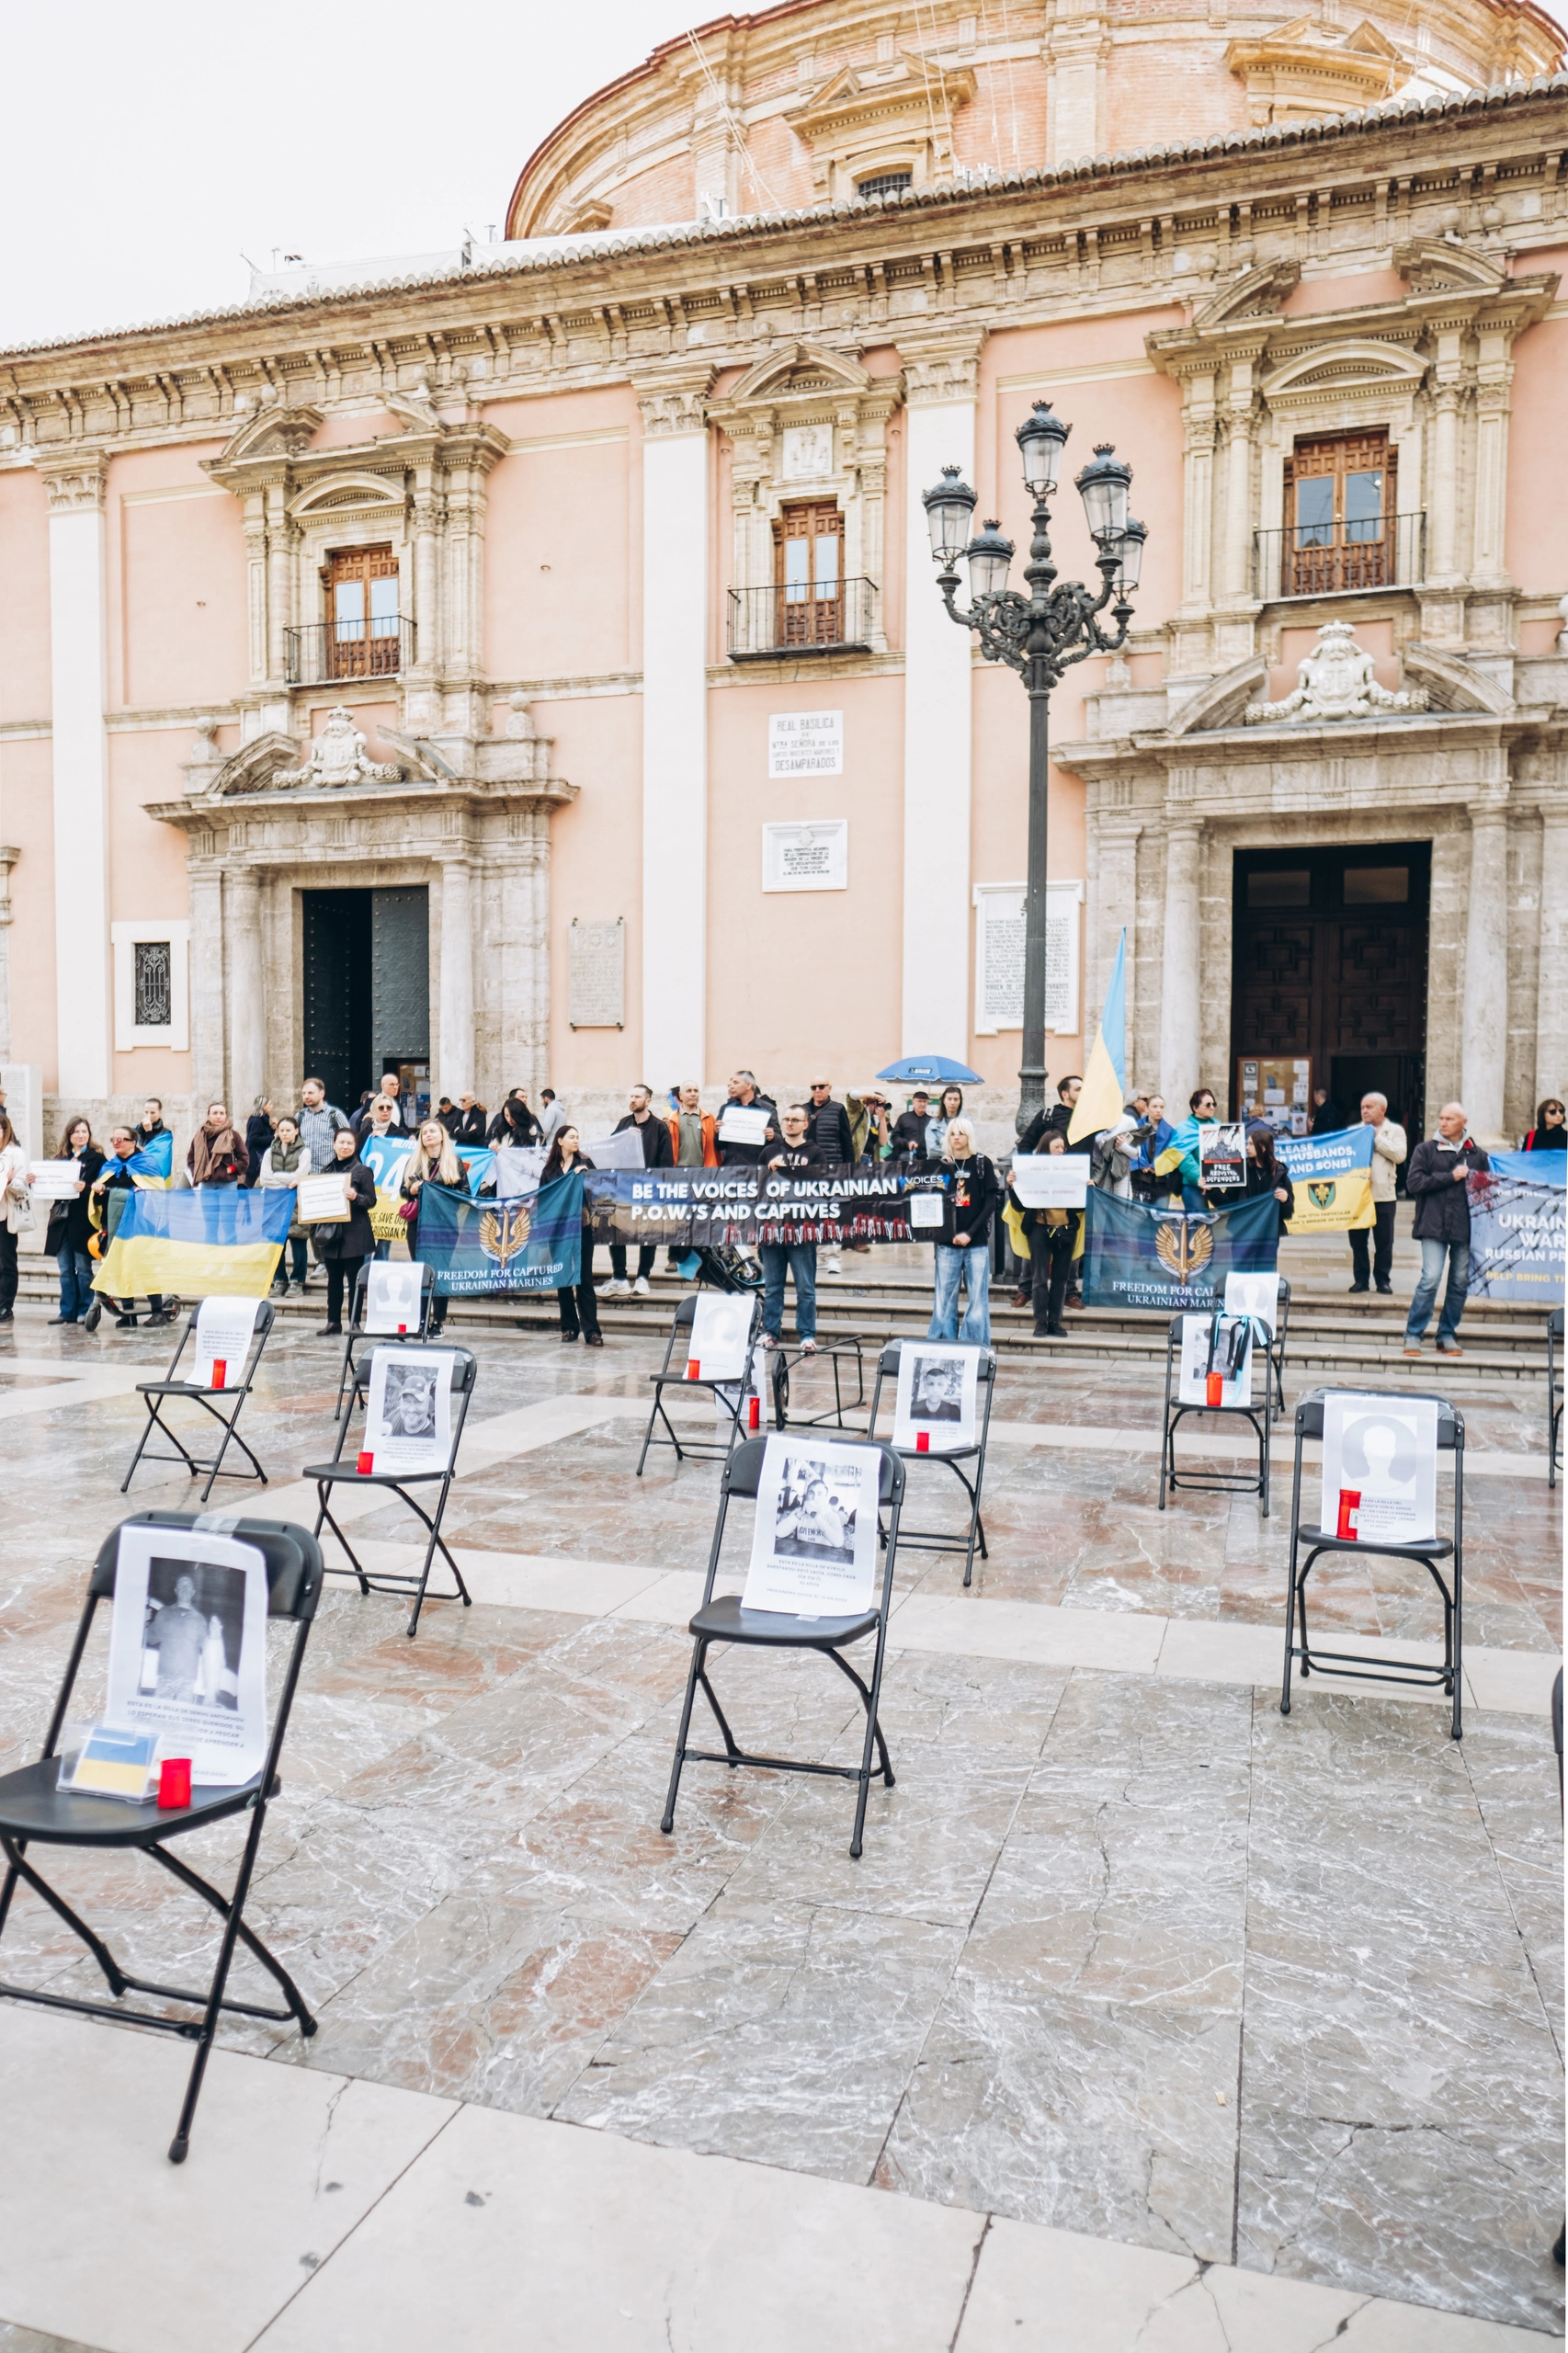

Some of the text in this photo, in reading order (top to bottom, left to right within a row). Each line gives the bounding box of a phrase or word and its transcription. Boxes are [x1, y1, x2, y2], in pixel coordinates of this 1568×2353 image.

[777, 718, 834, 732] REAL BASILICA
[791, 738, 815, 748] SEÑORA
[775, 757, 836, 771] DESAMPARADOS
[1274, 1143, 1314, 1154] PLEASE
[1289, 1146, 1356, 1162] HUSBANDS,
[1288, 1158, 1352, 1175] AND SONS!
[905, 1175, 943, 1184] VOICES
[632, 1183, 653, 1199] BE
[657, 1182, 688, 1198] THE
[692, 1182, 758, 1198] VOICES
[766, 1181, 791, 1197] OF
[794, 1178, 897, 1197] UKRAINIAN
[711, 1203, 751, 1220] AND
[754, 1202, 841, 1220] CAPTIVES
[378, 1213, 393, 1223] SAVE
[1485, 1248, 1545, 1261] RUSSIAN
[437, 1263, 563, 1280] FREEDOM FOR CAPTURED
[1486, 1271, 1513, 1280] HELP
[1516, 1273, 1550, 1282] BRING
[451, 1276, 553, 1291] UKRAINIAN MARINES
[1113, 1281, 1167, 1295] FREEDOM
[1170, 1286, 1192, 1296] FOR
[1127, 1295, 1187, 1307] UKRAINIAN
[137, 1711, 166, 1720] ESPERAN
[204, 1738, 239, 1747] APRENDER
